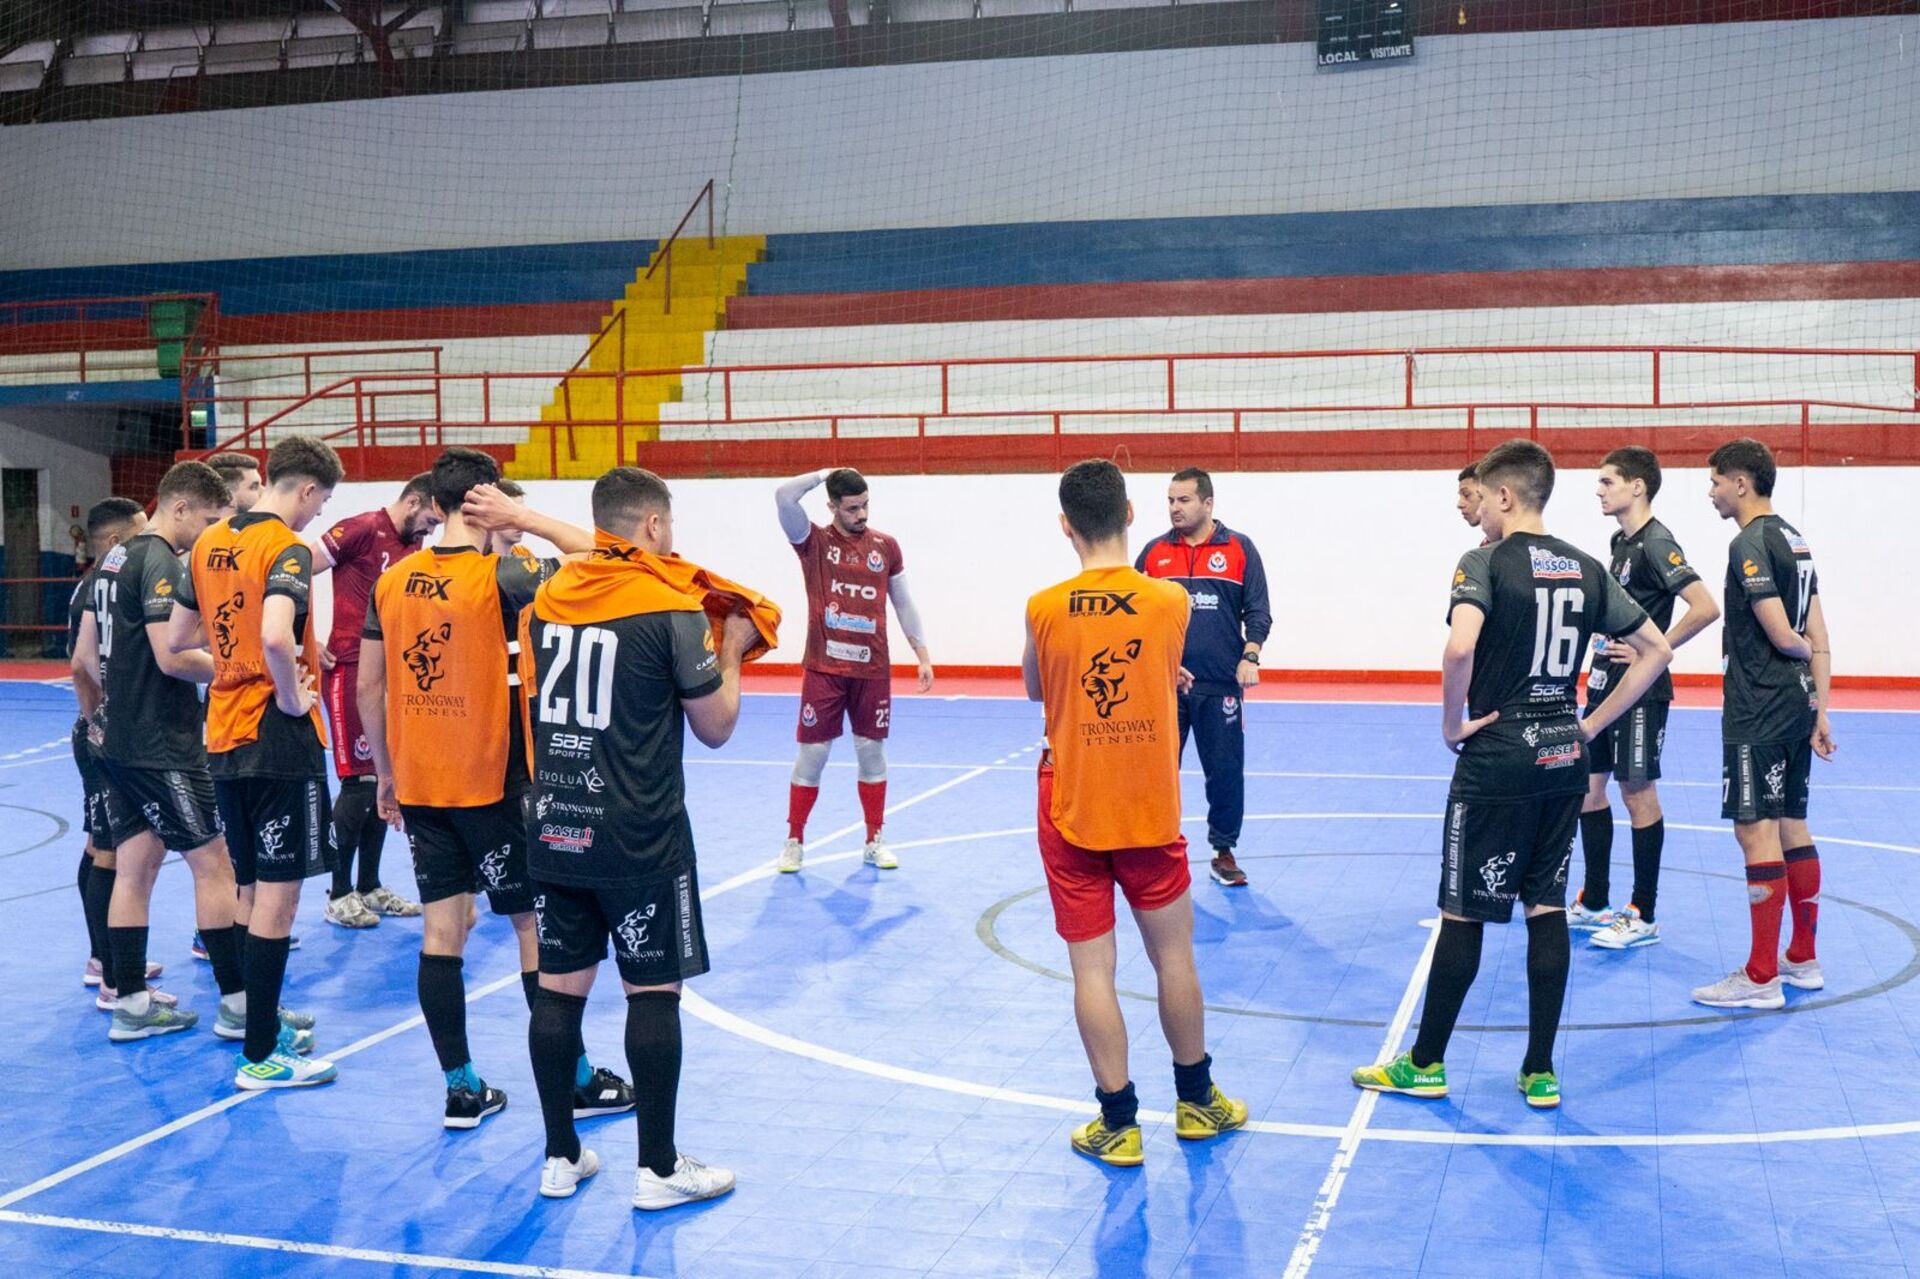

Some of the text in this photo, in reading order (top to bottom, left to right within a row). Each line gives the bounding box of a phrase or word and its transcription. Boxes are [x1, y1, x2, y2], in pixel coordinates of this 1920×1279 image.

[1319, 44, 1411, 64] LOCAL VISITANTE
[830, 578, 877, 600] KTO
[1792, 559, 1814, 633] 17
[1527, 587, 1585, 678] 16
[540, 623, 619, 731] 20
[550, 732, 594, 751] SBE
[548, 748, 591, 760] SPORTS
[538, 769, 583, 786] EVOLUA
[551, 801, 605, 816] STRONGWAY
[542, 823, 581, 839] CASE
[1449, 842, 1458, 870] ALEGRIA
[1449, 870, 1458, 891] MINHA
